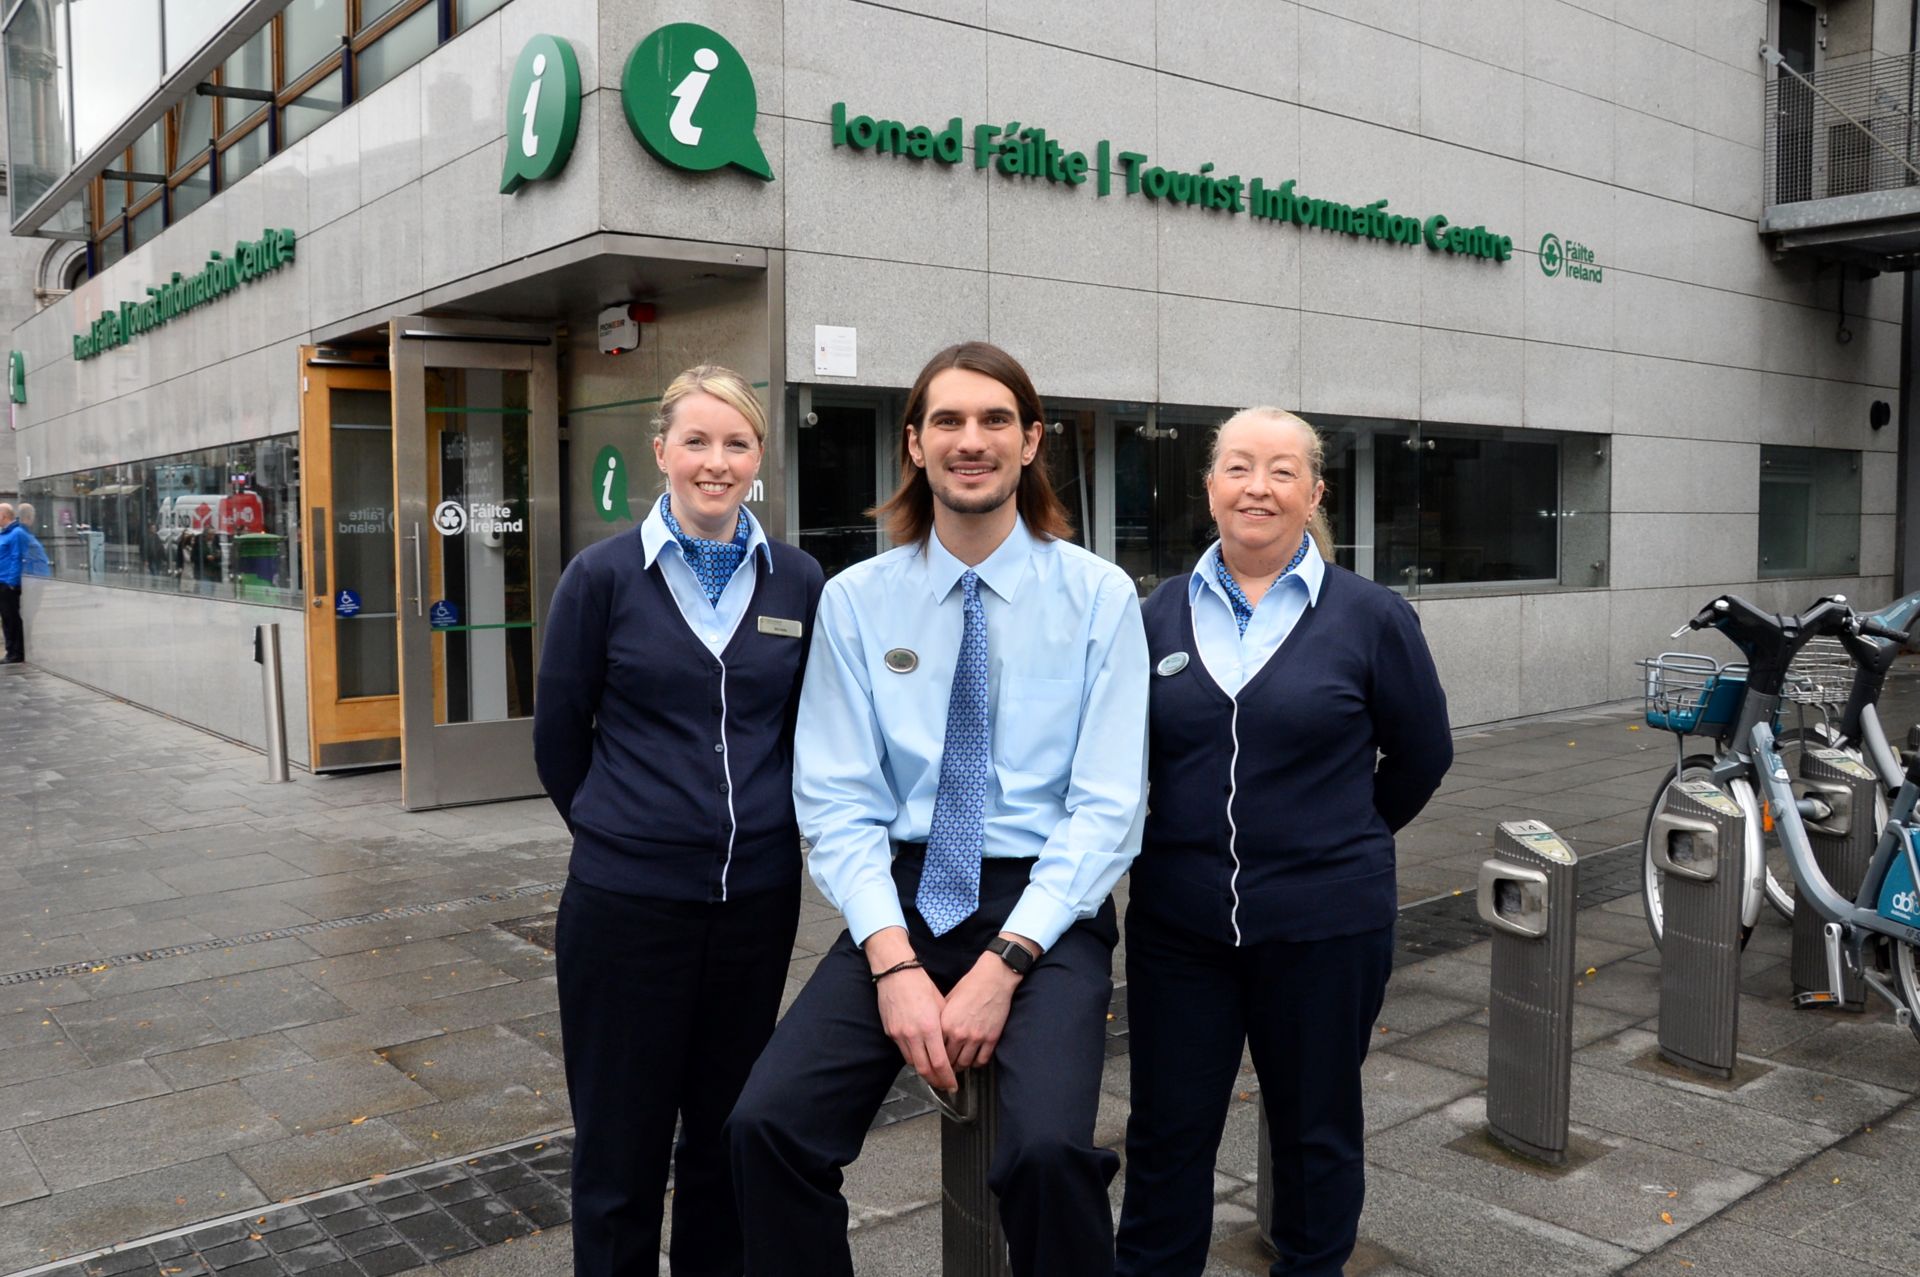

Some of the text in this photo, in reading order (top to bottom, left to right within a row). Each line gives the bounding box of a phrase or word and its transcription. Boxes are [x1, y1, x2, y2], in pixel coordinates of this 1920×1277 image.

[832, 102, 963, 165] Ionad
[974, 121, 1088, 186] Fáilte
[1118, 151, 1245, 214] Tourist
[1250, 176, 1422, 246] Information
[1423, 214, 1513, 261] Centre
[234, 228, 296, 284] Centre
[1565, 240, 1595, 263] Fáilte
[1565, 260, 1603, 283] Ireland
[470, 503, 511, 518] Fáilte
[470, 518, 523, 532] Ireland
